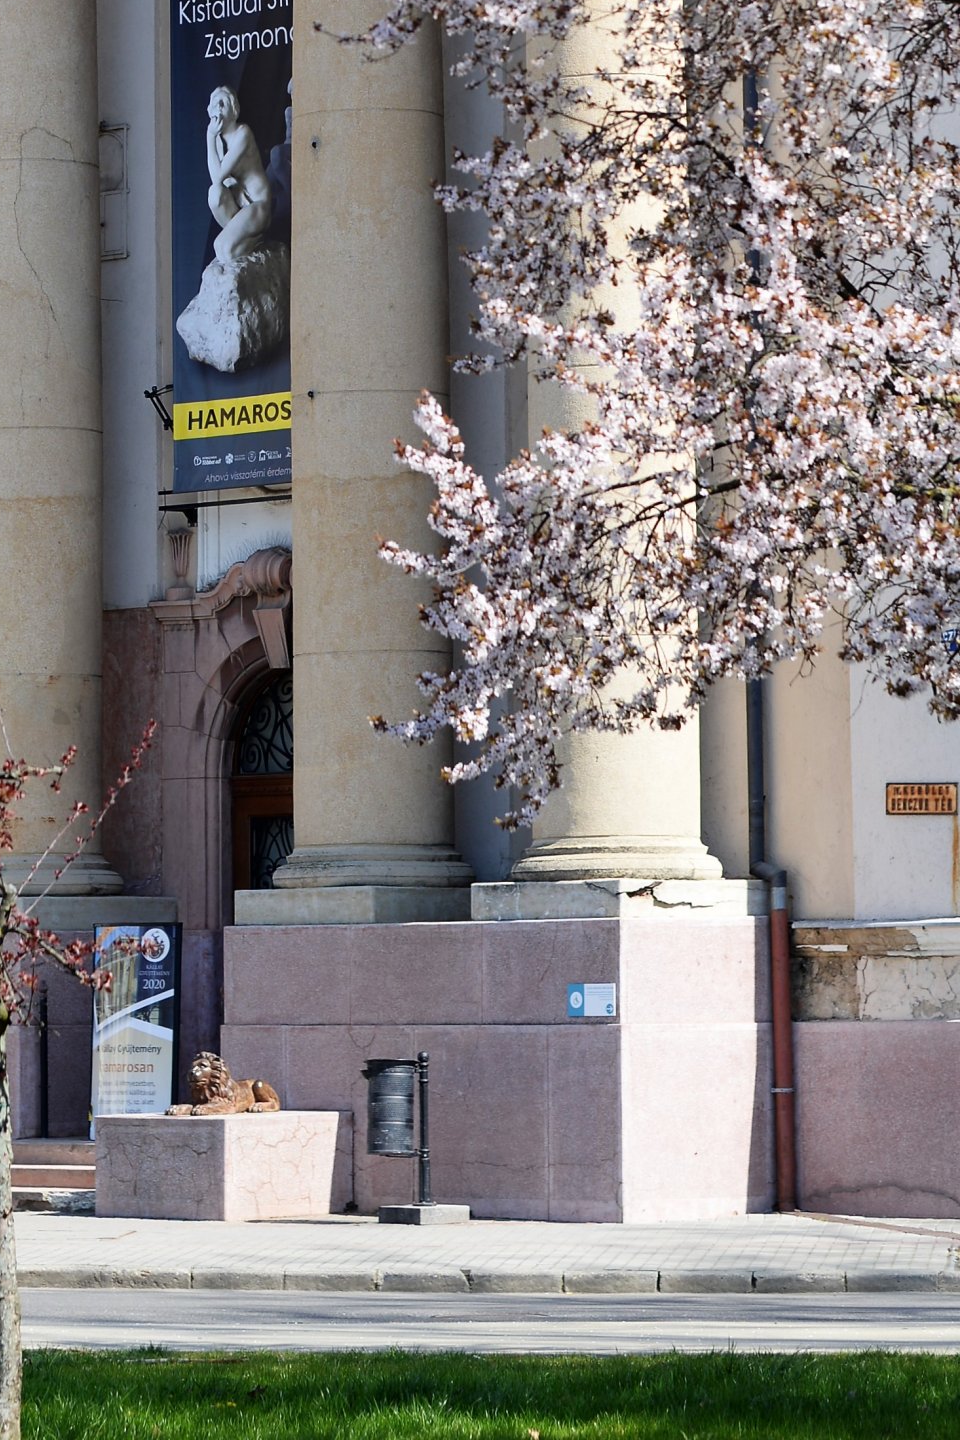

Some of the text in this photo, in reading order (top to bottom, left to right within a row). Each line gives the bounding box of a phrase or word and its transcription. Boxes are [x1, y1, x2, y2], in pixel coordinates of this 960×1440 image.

[188, 400, 292, 430] HAMAROS
[142, 978, 166, 990] 2020
[100, 1062, 154, 1073] amarosan
